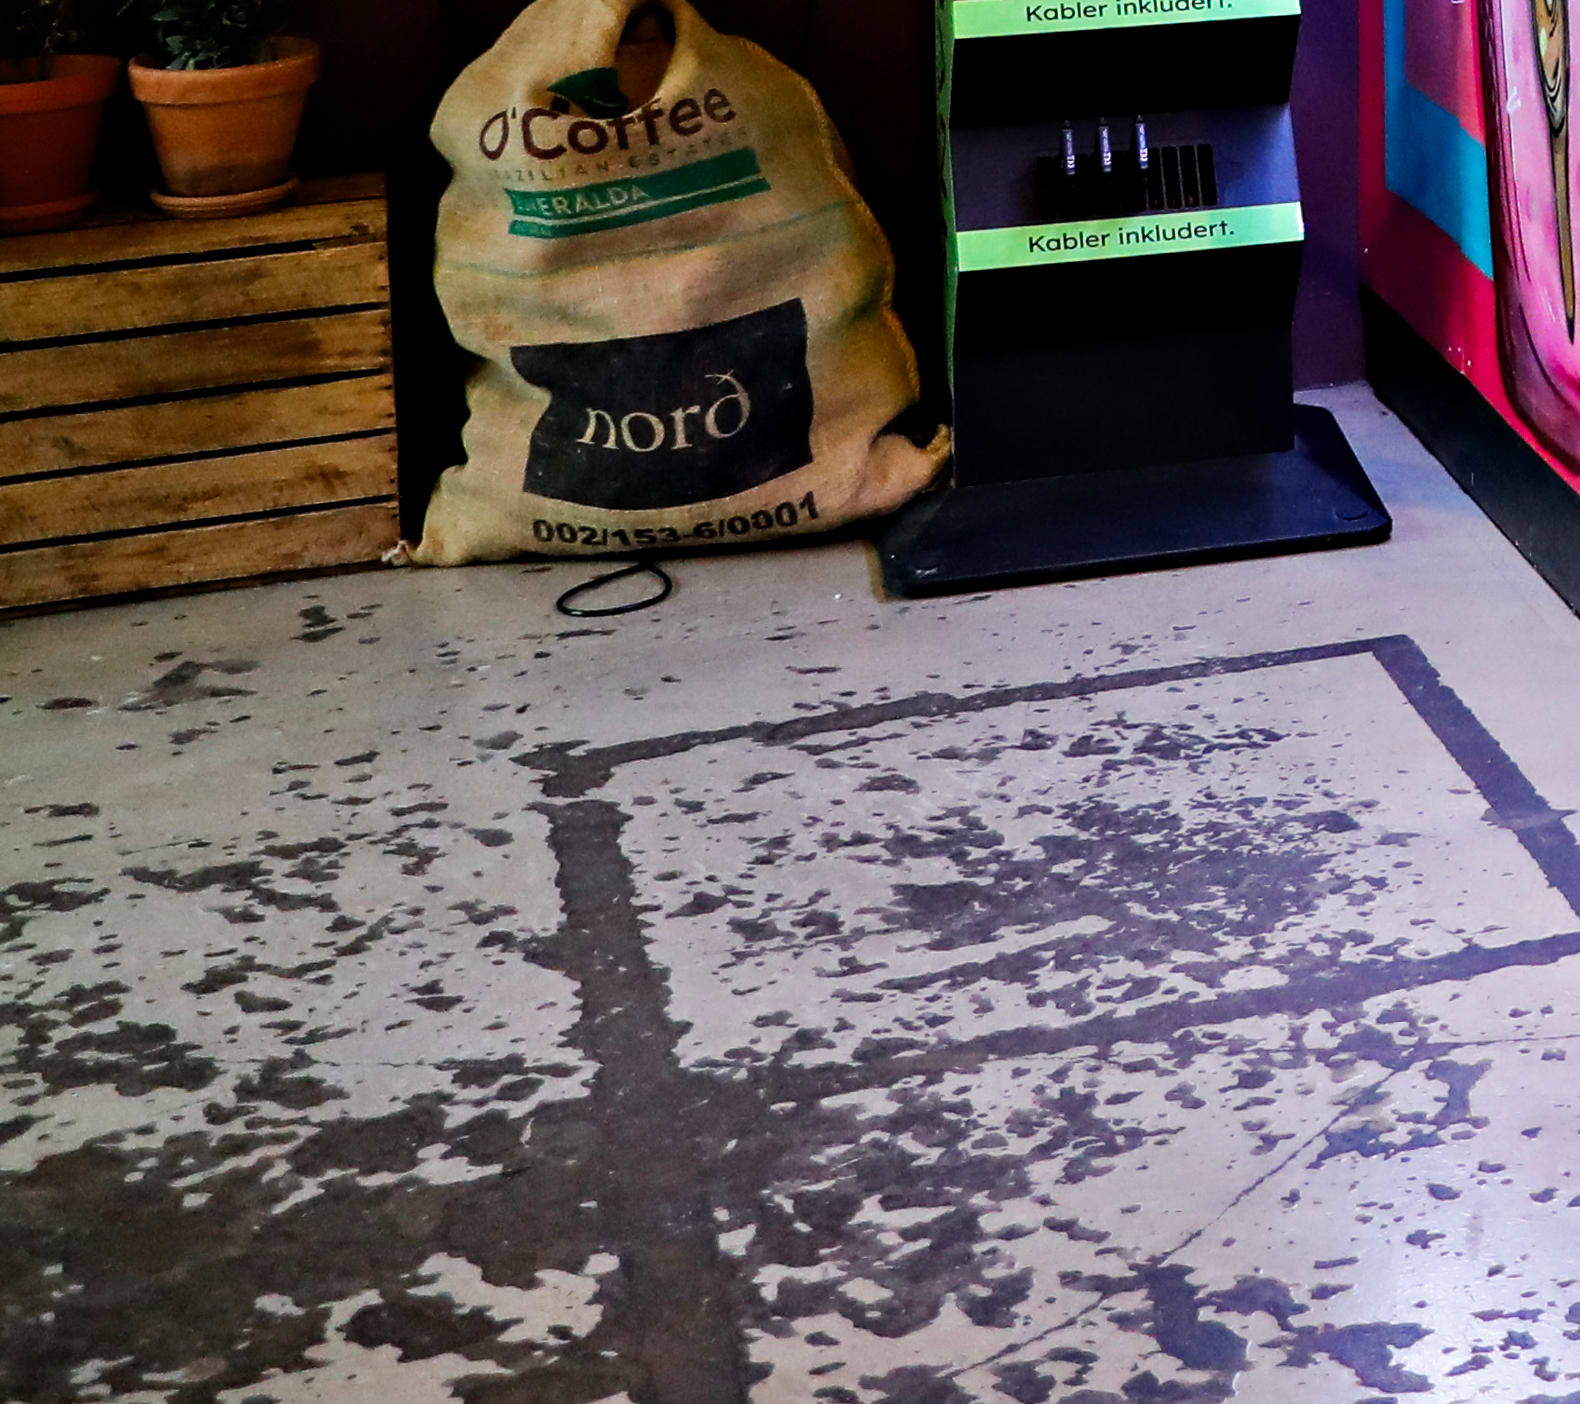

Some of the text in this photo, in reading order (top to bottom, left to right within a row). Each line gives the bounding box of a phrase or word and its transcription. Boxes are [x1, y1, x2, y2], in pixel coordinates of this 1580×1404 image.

[1025, 0, 1109, 23] Kabler
[1027, 219, 1235, 253] Kabler inkludert.
